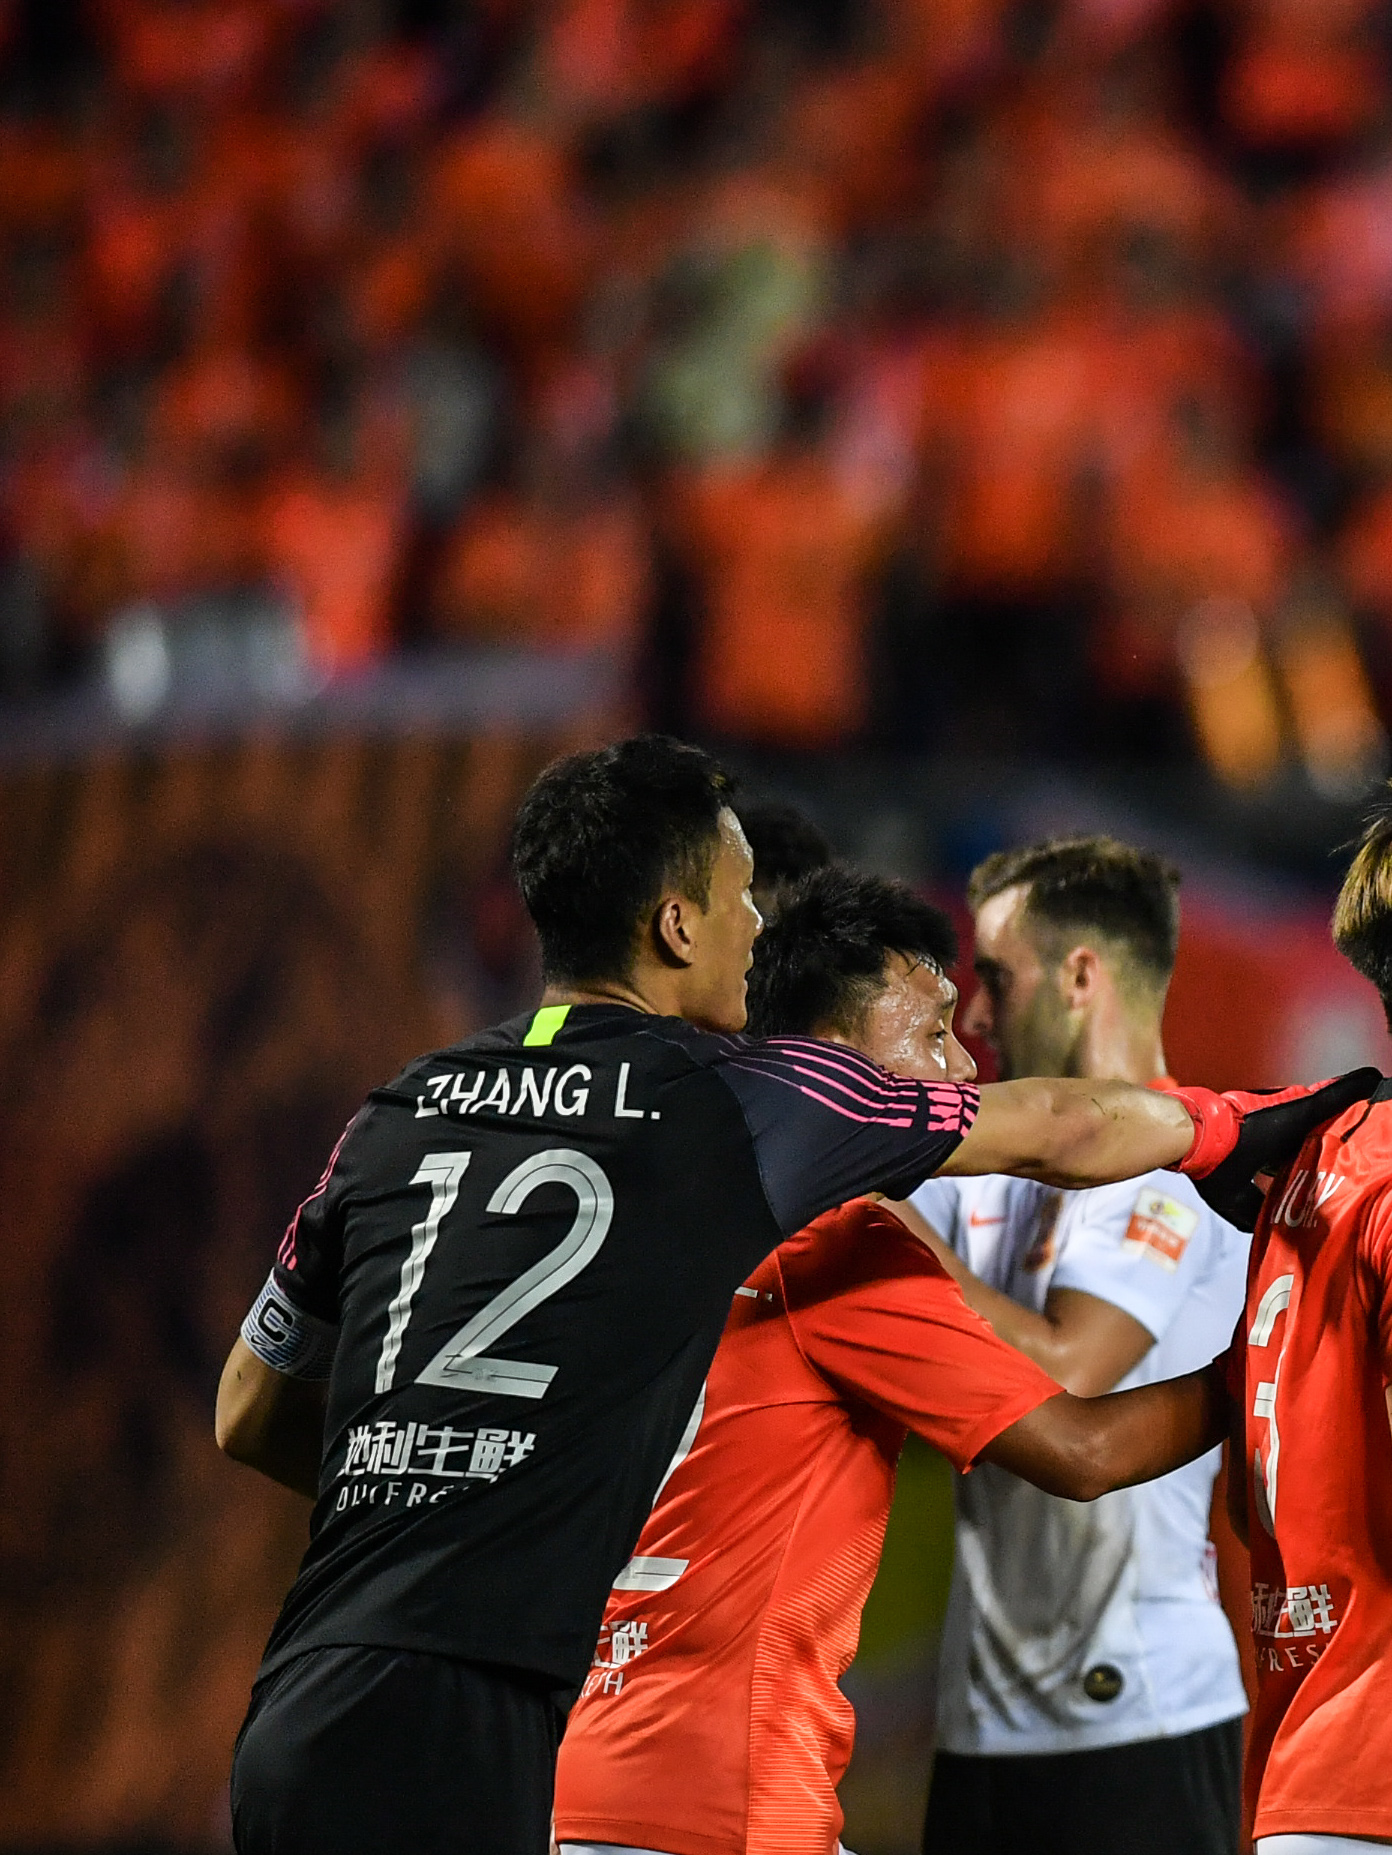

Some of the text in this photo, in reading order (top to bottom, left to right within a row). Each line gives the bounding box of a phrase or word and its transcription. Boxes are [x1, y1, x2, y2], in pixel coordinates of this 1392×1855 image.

[414, 1061, 662, 1121] ZHANG L.
[373, 1147, 615, 1400] 12
[257, 1297, 295, 1344] C
